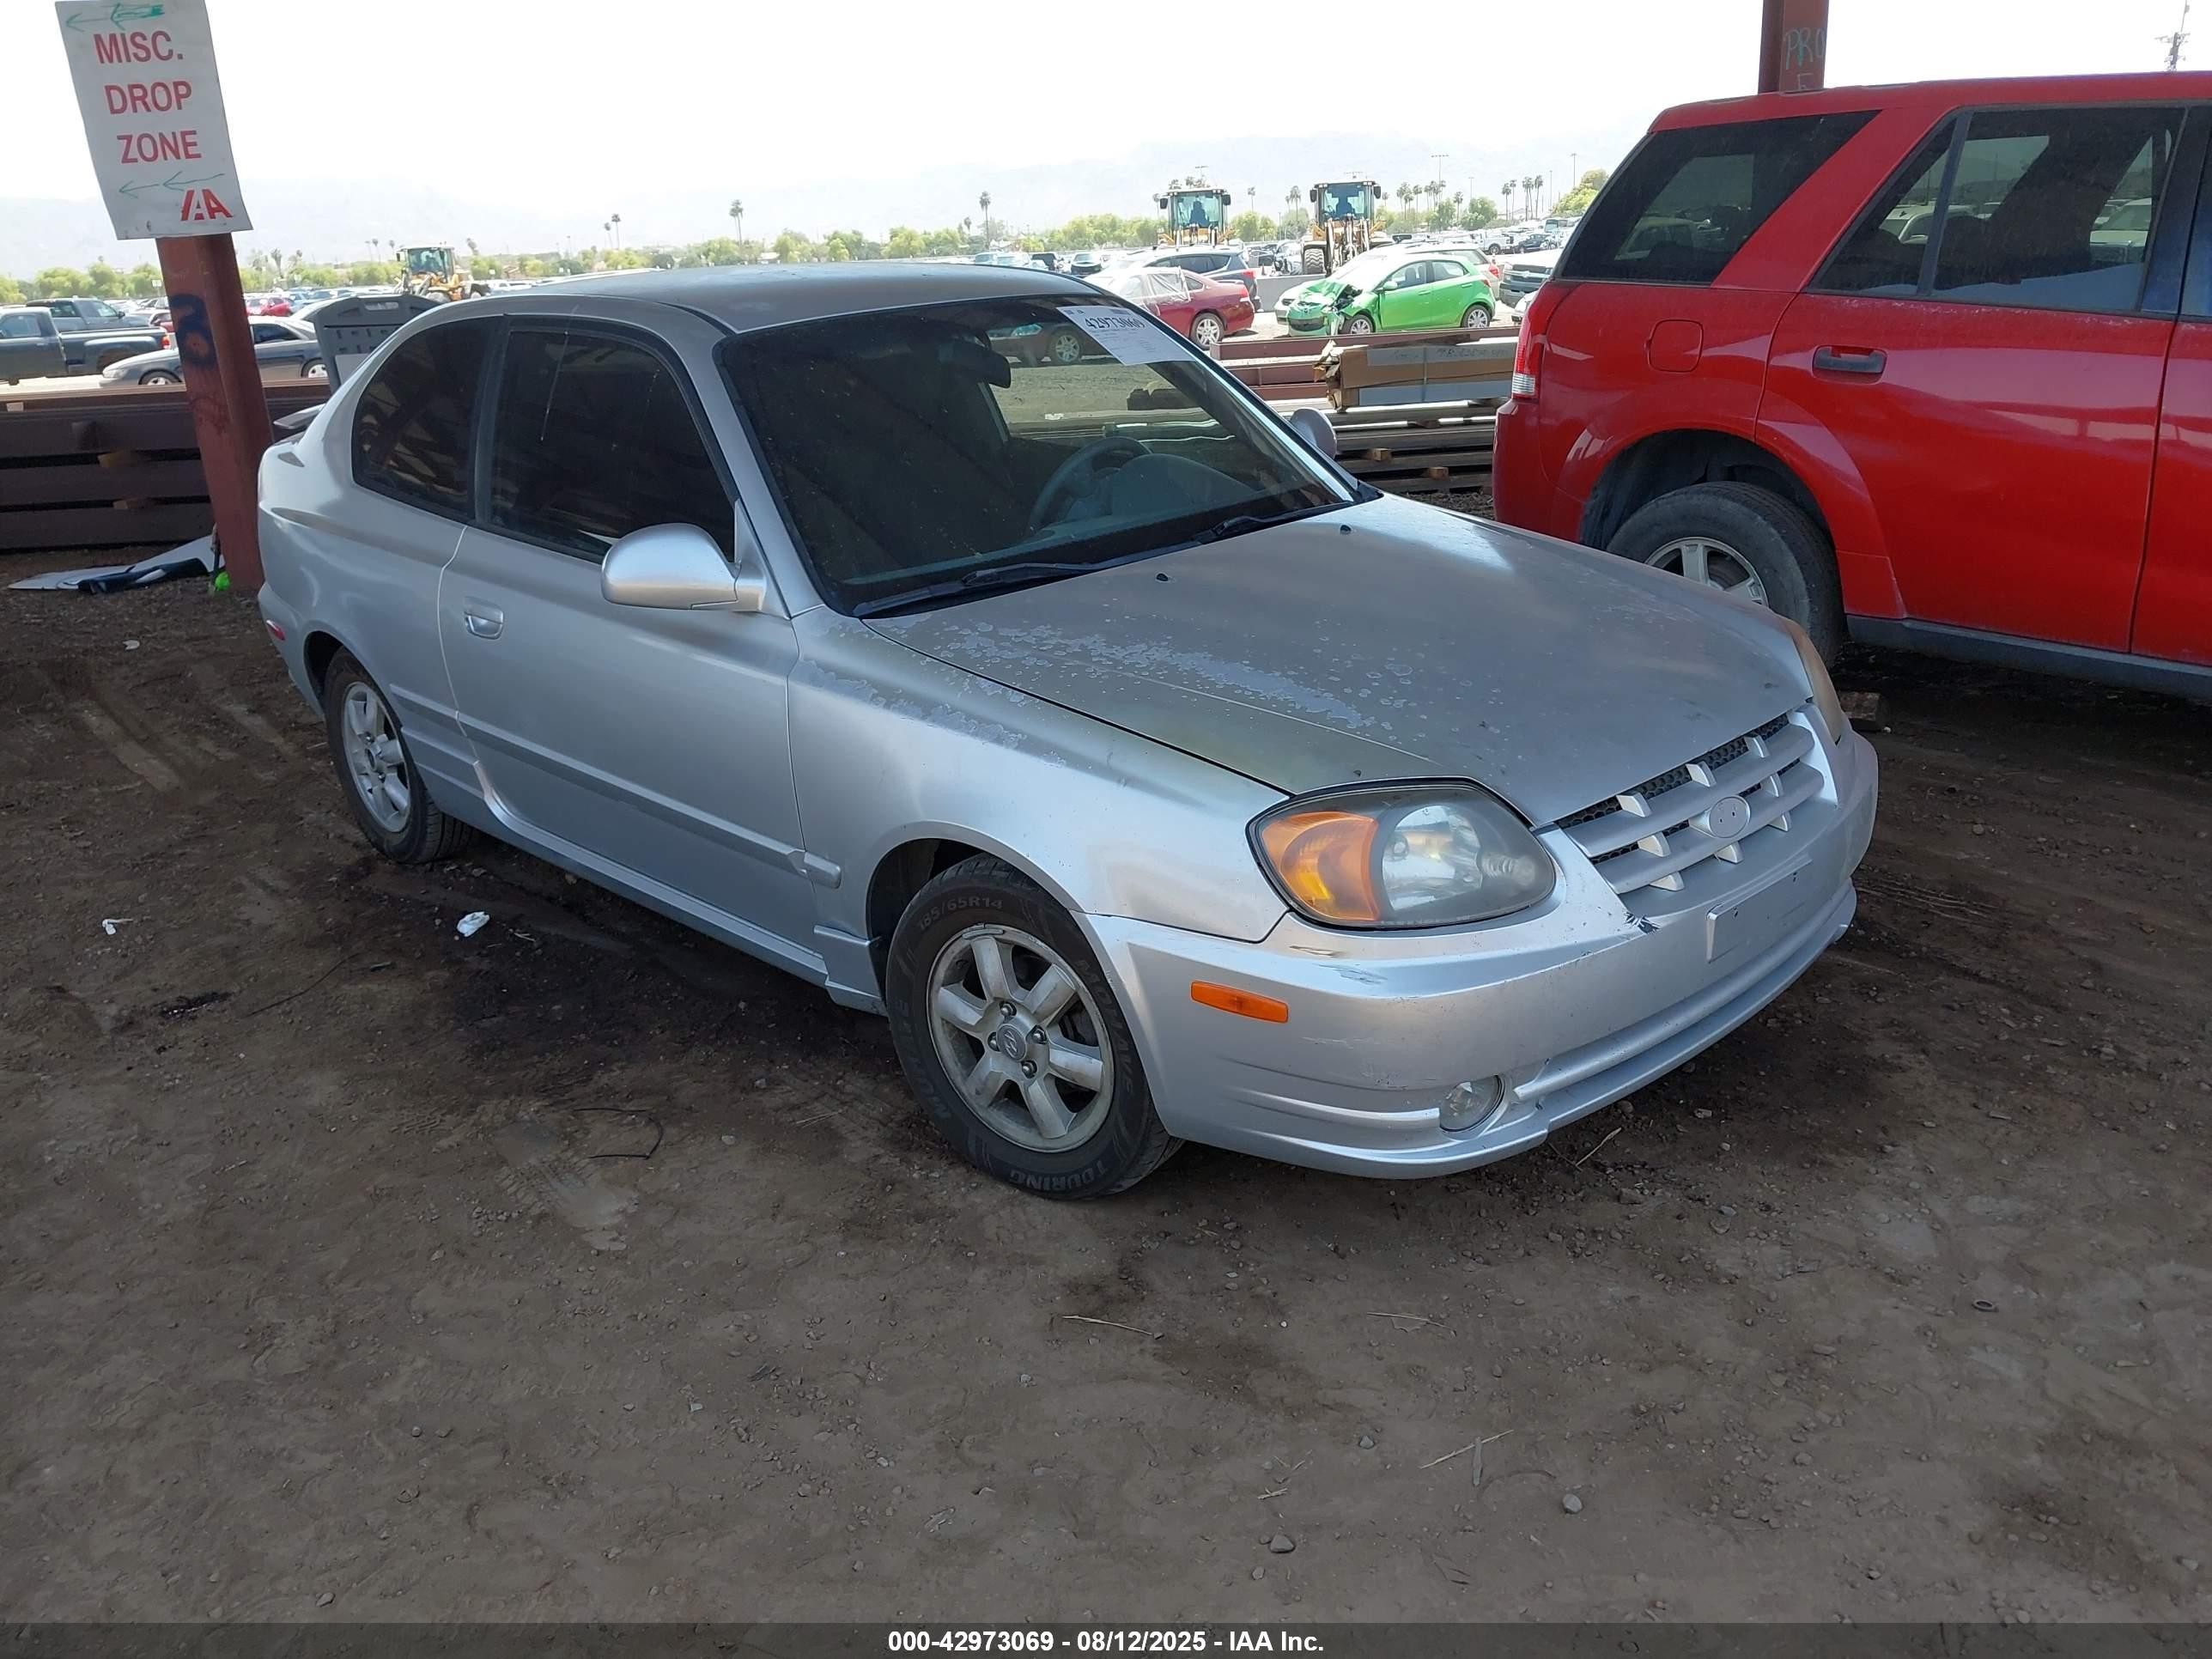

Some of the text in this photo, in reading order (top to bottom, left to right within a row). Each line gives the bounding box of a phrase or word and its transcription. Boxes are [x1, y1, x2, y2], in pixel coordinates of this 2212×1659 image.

[94, 30, 184, 64] MISC.
[104, 81, 192, 115] DROP
[117, 130, 202, 164] ZONE
[1085, 316, 1146, 329] 42973069
[919, 896, 1004, 931] 185/65R14
[1009, 1160, 1108, 1191] TOURING
